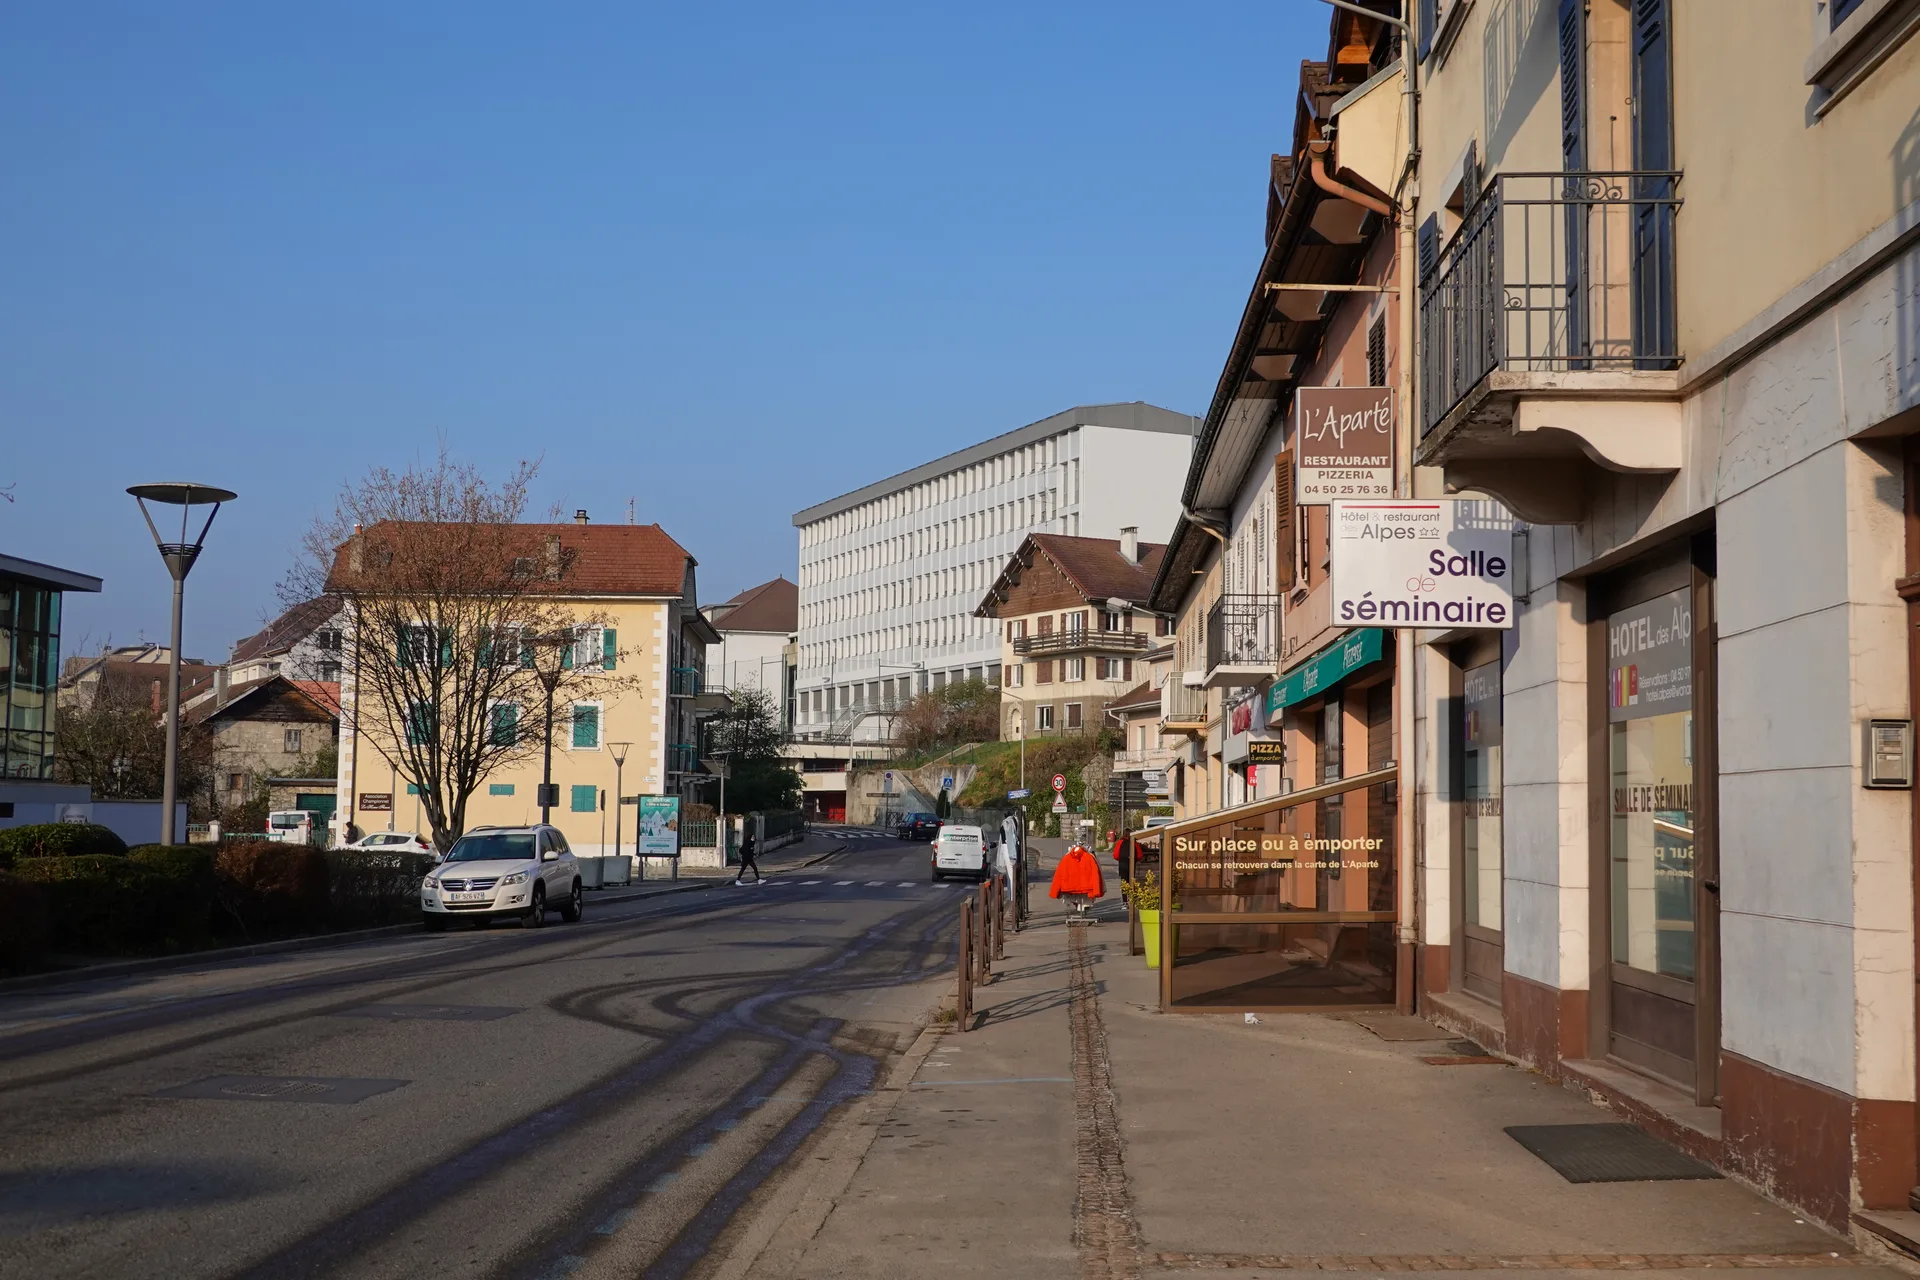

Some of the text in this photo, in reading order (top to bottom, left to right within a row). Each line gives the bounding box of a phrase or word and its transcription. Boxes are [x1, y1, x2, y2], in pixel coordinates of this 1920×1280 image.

[1304, 396, 1390, 449] L'Aparté
[1304, 456, 1388, 466] RESTAURANT
[1318, 470, 1374, 480] PIZZERIA
[1304, 485, 1388, 494] 04 50 25 76 36
[1340, 512, 1369, 521] Hôtel
[1383, 512, 1440, 521] restaurant
[1340, 523, 1415, 542] des Alpes
[1429, 549, 1506, 577] Salle
[1406, 574, 1436, 592] de
[1340, 591, 1506, 623] séminaire
[1611, 605, 1692, 658] HOTEL des Alp
[1465, 676, 1487, 704] HOTEL
[1250, 744, 1282, 753] PIZZA
[1055, 778, 1063, 787] 30
[1614, 778, 1693, 812] SALLE DE SÉMINAI
[1175, 836, 1383, 854] Sur place ou à emporter
[1175, 861, 1209, 869] Chacun
[1271, 861, 1292, 869] dans
[1304, 861, 1327, 869] carte
[1342, 860, 1379, 870] L'Aparté
